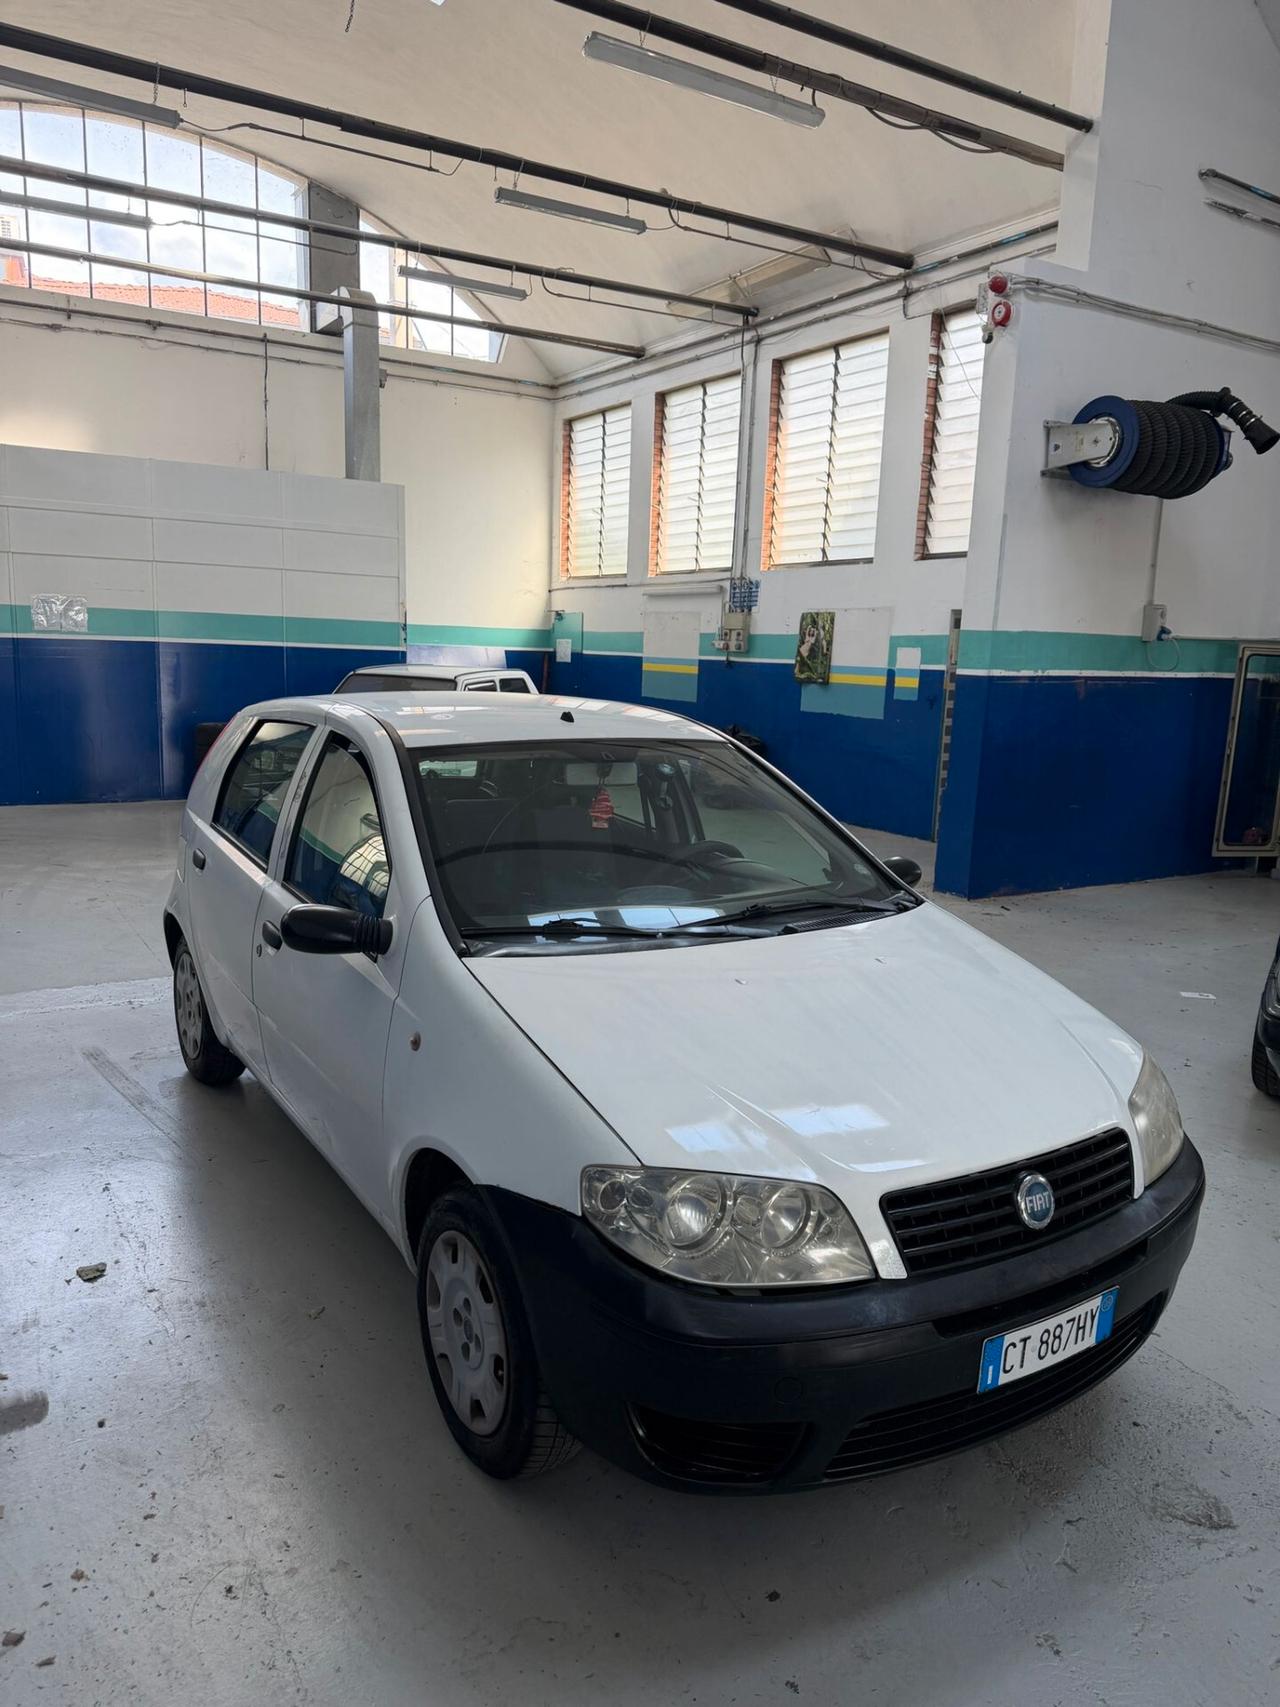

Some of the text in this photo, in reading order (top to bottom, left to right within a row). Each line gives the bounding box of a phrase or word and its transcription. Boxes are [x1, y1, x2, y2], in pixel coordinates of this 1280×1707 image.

[1025, 1191, 1050, 1214] FIAT
[1002, 1304, 1100, 1375] CT 887HY
